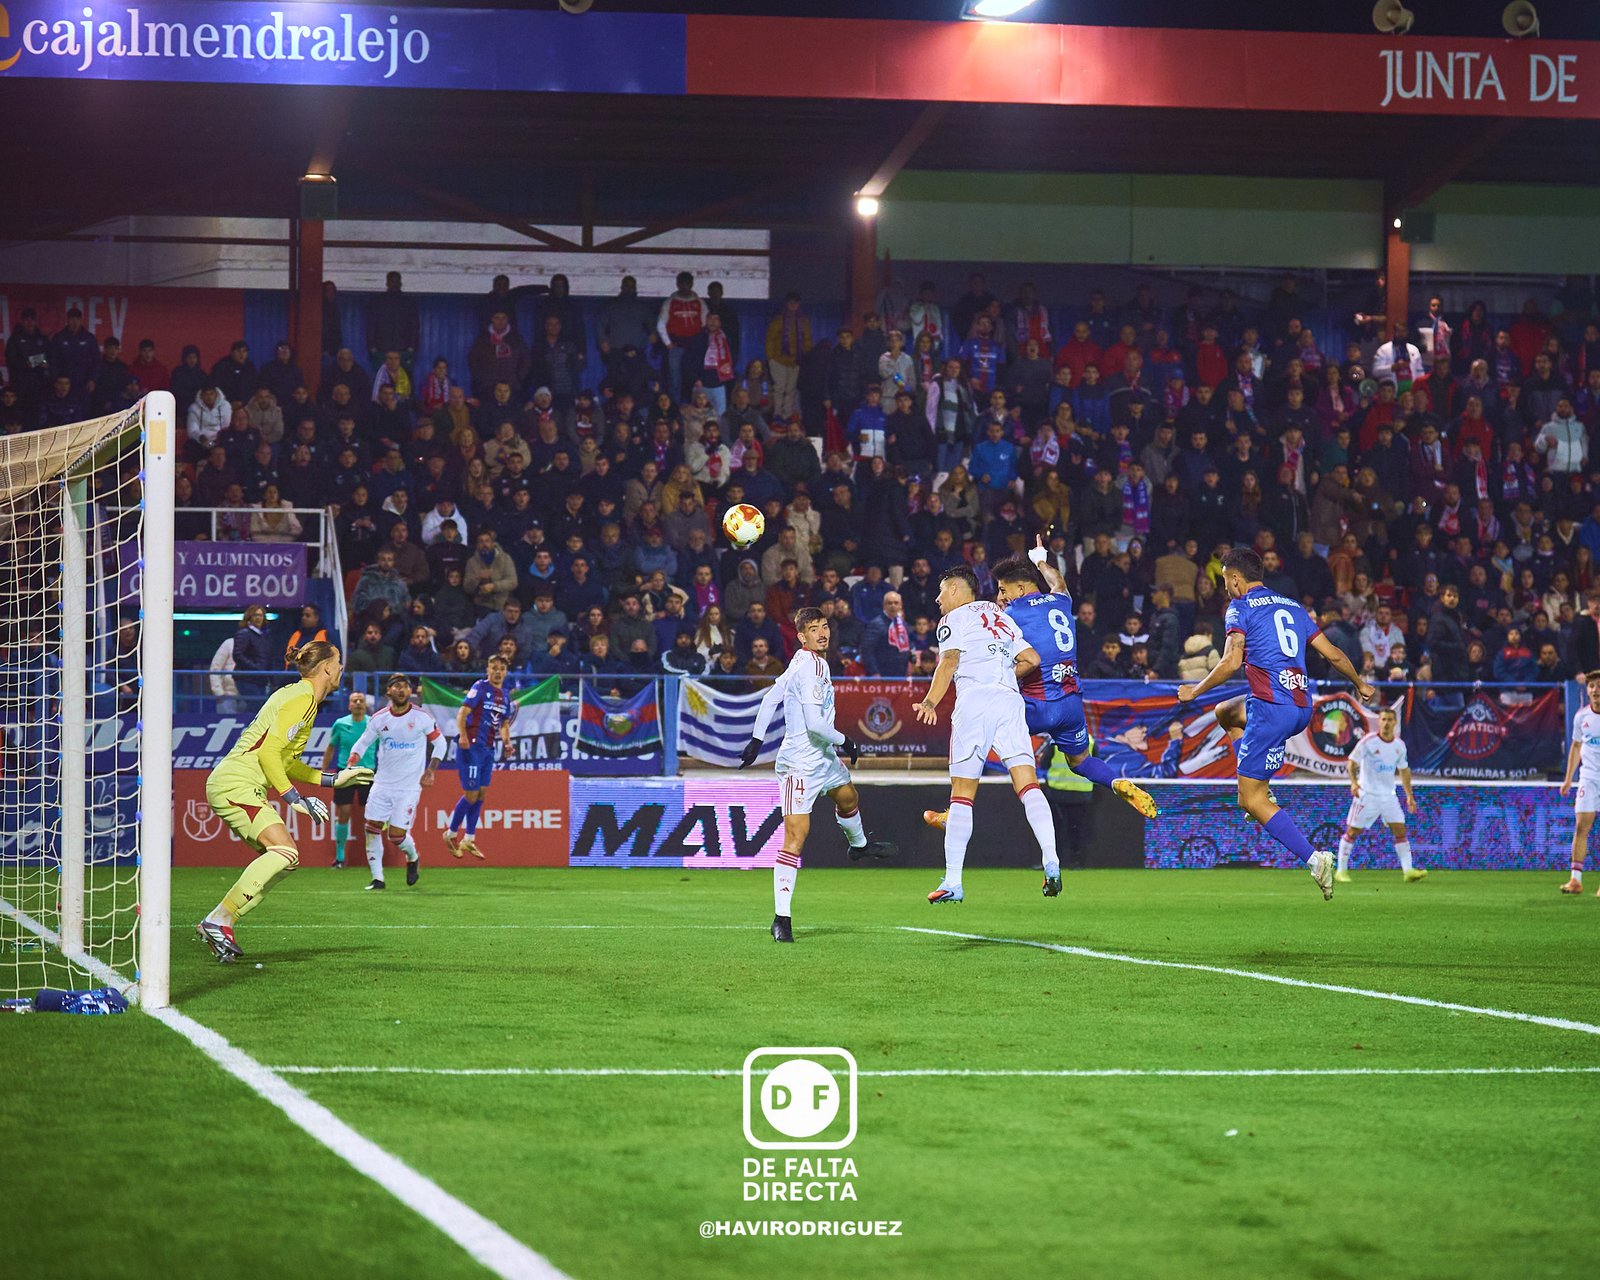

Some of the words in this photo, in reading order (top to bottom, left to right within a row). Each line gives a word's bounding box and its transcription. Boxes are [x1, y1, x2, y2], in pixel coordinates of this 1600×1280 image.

[22, 7, 430, 78] cajalmendralejo
[1379, 50, 1506, 106] JUNTA
[1529, 55, 1578, 103] DE
[178, 552, 188, 565] Y
[195, 553, 293, 567] ALUMINIOS
[205, 574, 237, 597] DE
[245, 575, 298, 597] BOU
[1248, 596, 1273, 608] ROBE
[1048, 609, 1074, 652] 8
[1274, 609, 1298, 658] 6
[834, 683, 859, 694] PEÑA
[863, 685, 881, 694] LOS
[860, 745, 894, 753] DONDE
[899, 745, 927, 753] VAYAS
[469, 766, 478, 779] 11
[509, 763, 533, 771] 648
[538, 763, 562, 771] 588
[1313, 760, 1336, 775] CON
[1444, 768, 1506, 779] CAMINARAS
[795, 779, 805, 795] 4
